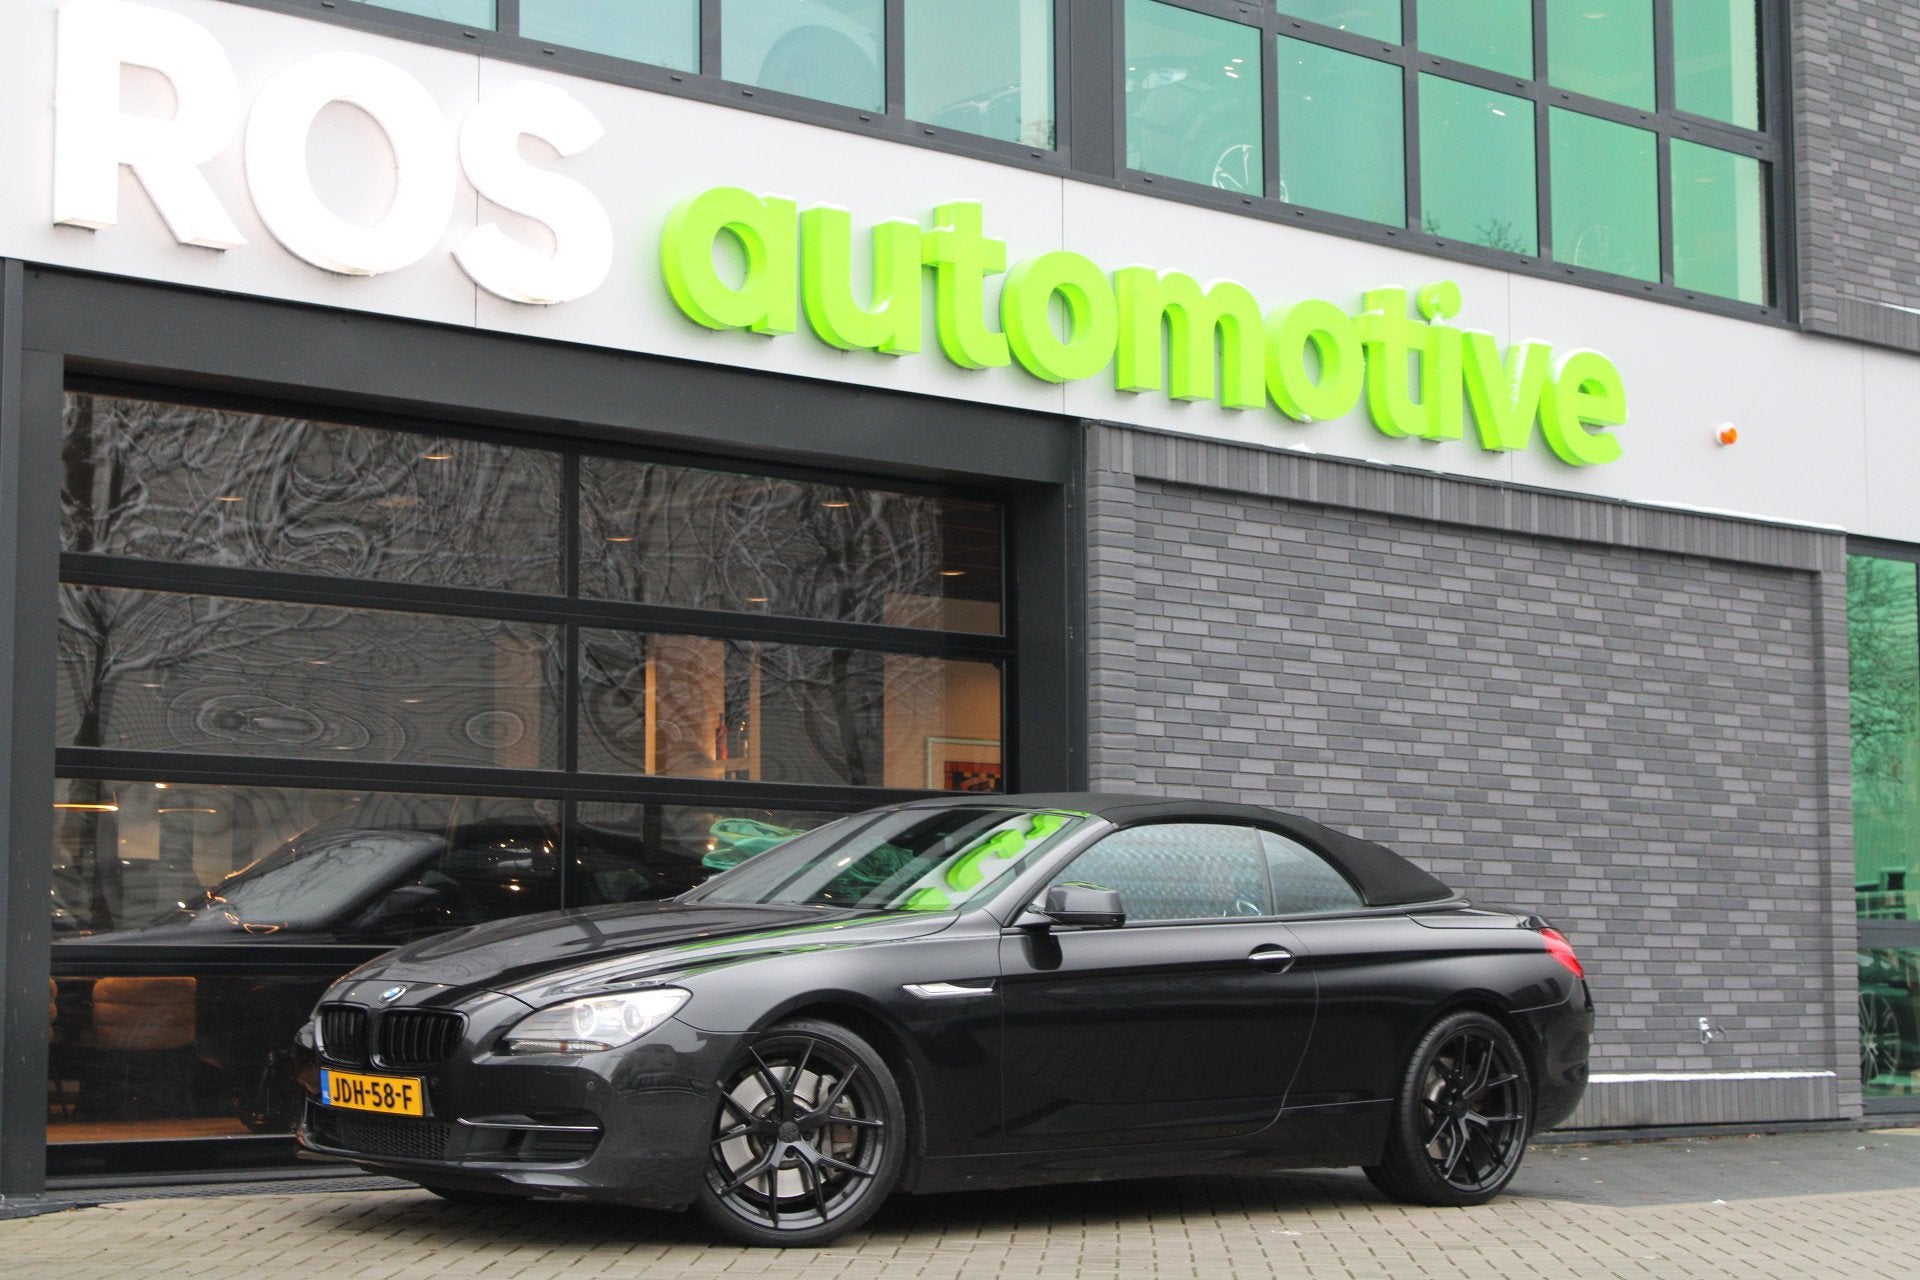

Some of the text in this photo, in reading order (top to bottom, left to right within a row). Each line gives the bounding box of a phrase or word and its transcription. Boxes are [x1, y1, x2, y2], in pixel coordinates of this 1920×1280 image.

[53, 0, 1628, 467] ROS automotive
[333, 1078, 412, 1110] JDH-58-F
